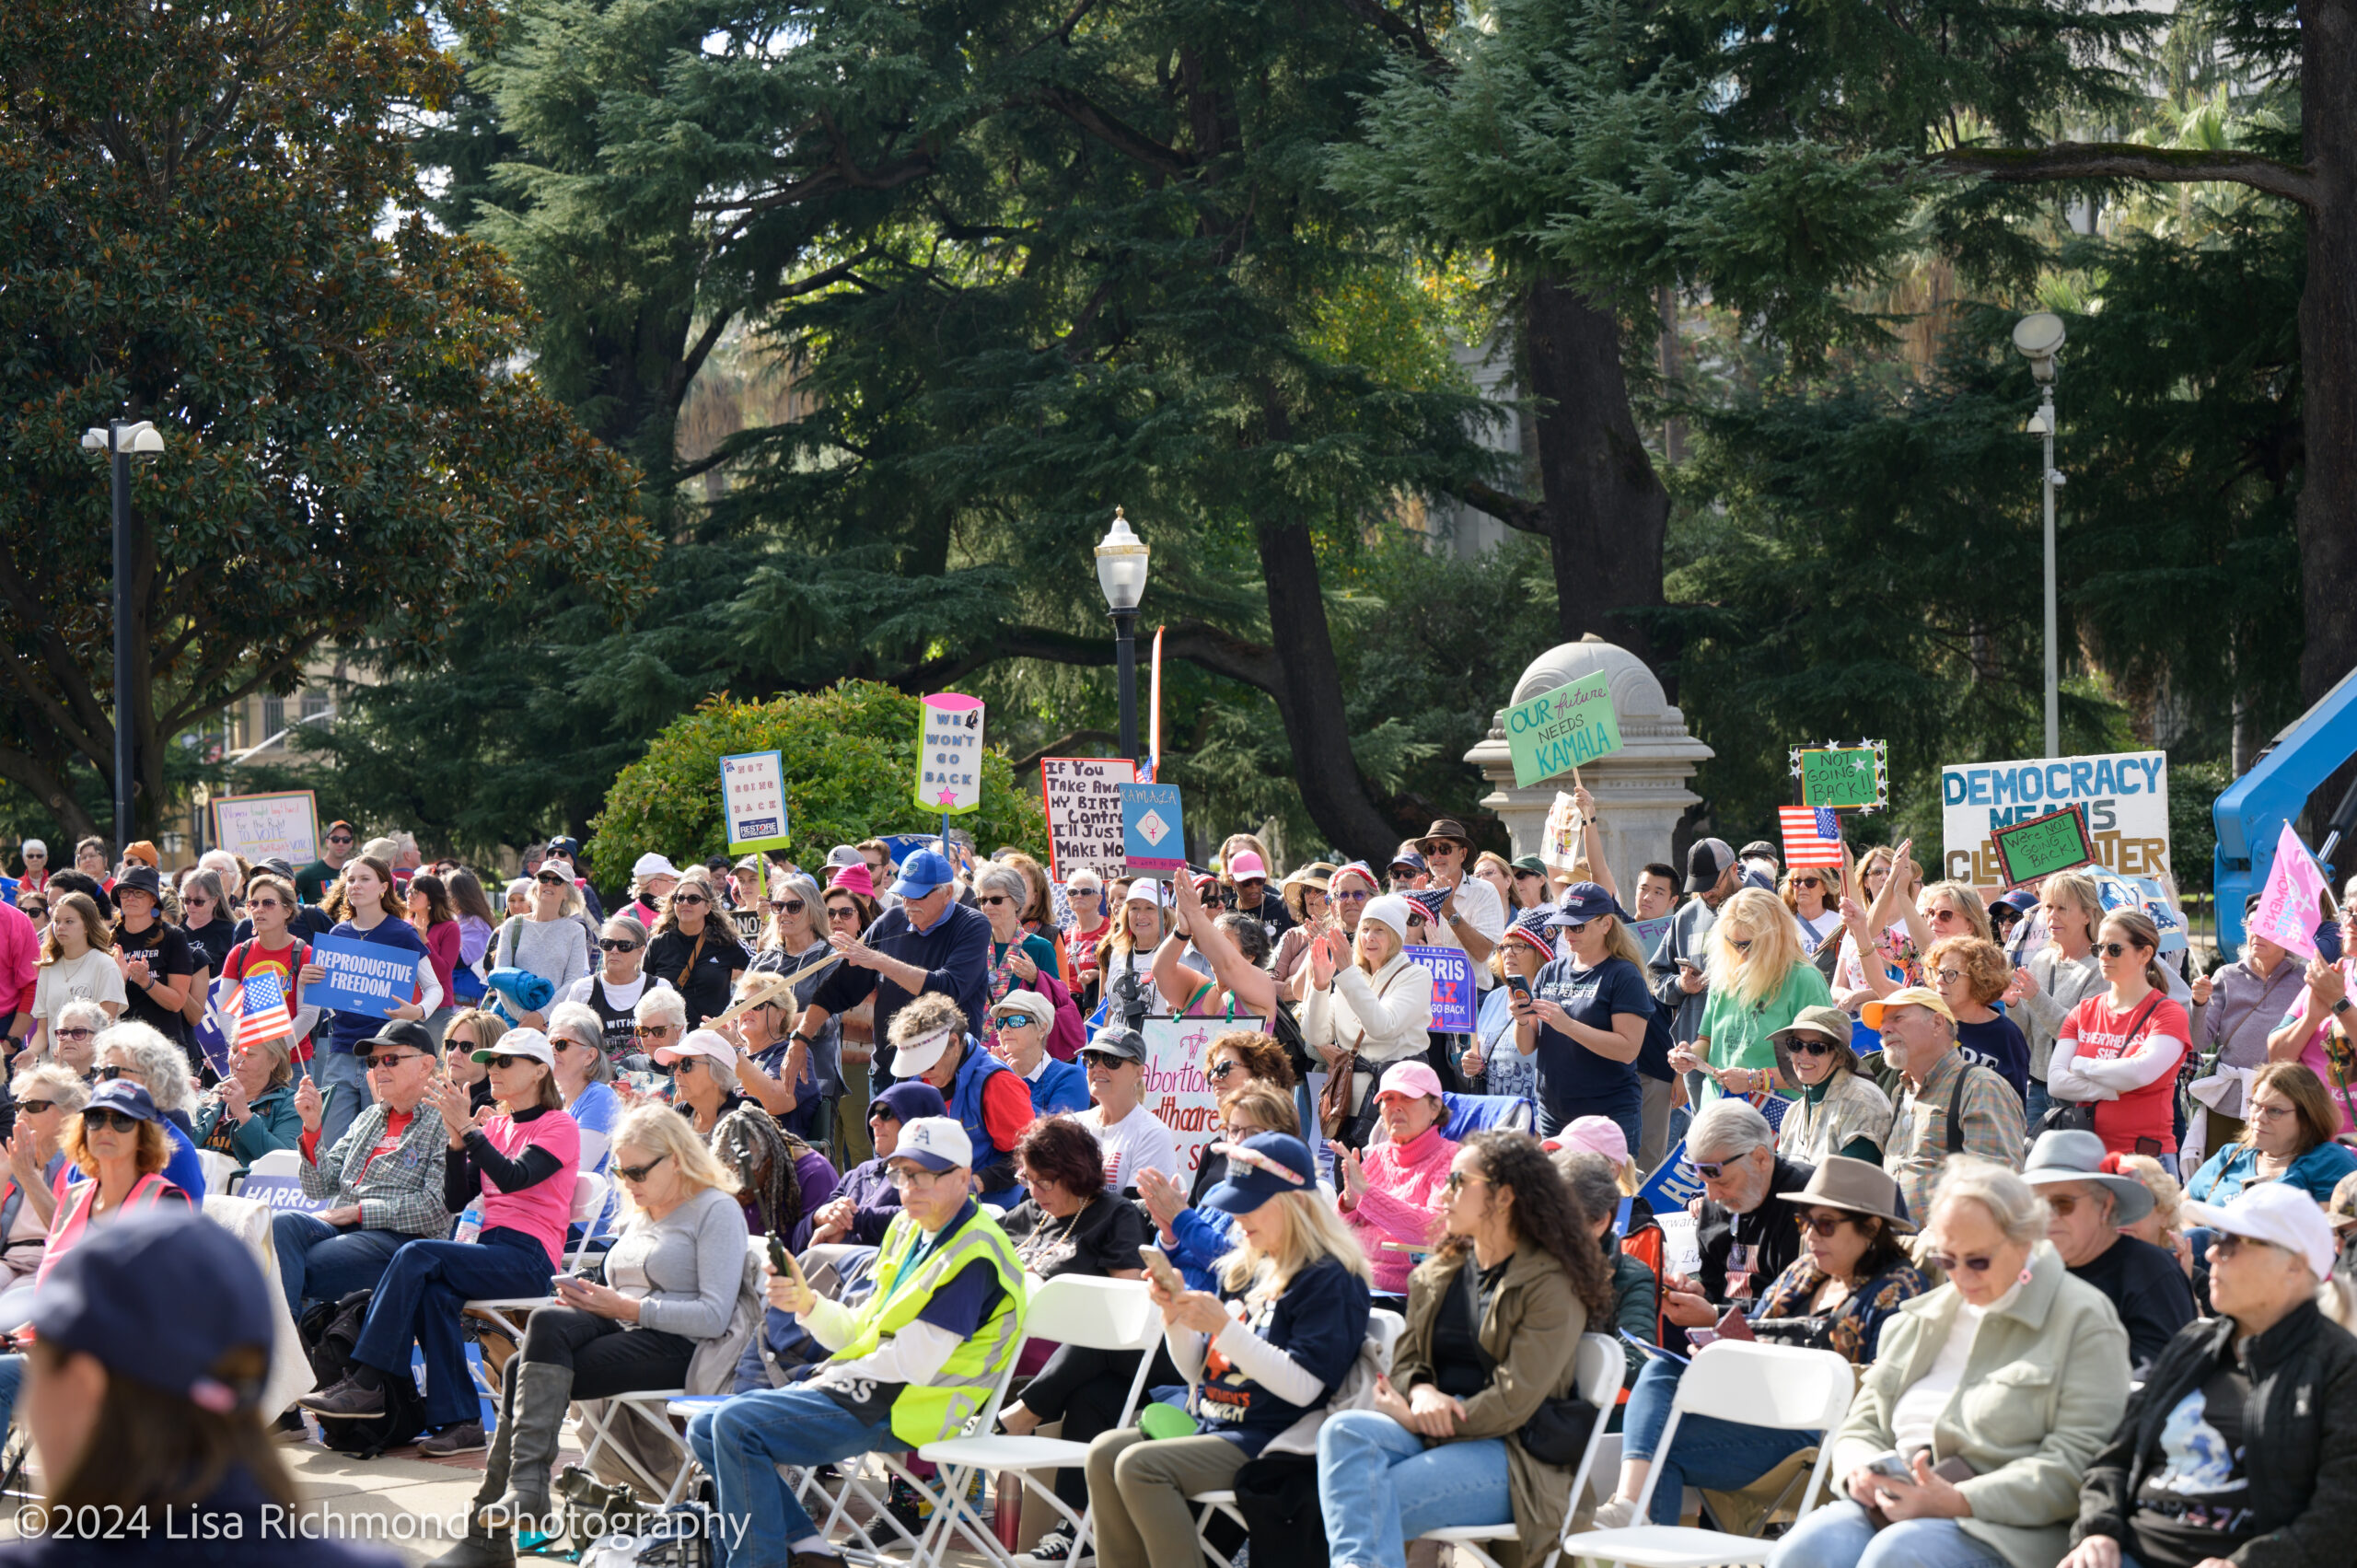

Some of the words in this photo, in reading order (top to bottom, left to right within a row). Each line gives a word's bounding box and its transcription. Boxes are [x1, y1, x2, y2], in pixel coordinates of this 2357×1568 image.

[1511, 699, 1553, 733] OUR
[1554, 688, 1607, 720] future
[936, 714, 961, 726] WE
[1538, 714, 1585, 744] NEEDS
[925, 734, 975, 747] WON'T
[1535, 722, 1611, 776] KAMALA
[936, 753, 959, 764] GO
[1820, 751, 1852, 766] NOT
[737, 762, 763, 774] NOT
[1806, 765, 1855, 782] GOING
[735, 780, 773, 793] GOING
[924, 772, 972, 785] BACK
[1943, 757, 2163, 806] DEMOCRACY
[1093, 780, 1120, 794] AWA
[1051, 796, 1070, 808] MY
[1078, 796, 1120, 809] BIRT
[1120, 788, 1178, 806] KAMALA
[735, 800, 777, 813] BACK
[1068, 808, 1123, 824] Contr
[740, 821, 776, 834] RESTORE
[2045, 817, 2068, 834] NOT
[238, 830, 250, 842] TO
[255, 827, 287, 842] VOTE
[1103, 842, 1124, 857] MO
[2021, 835, 2060, 856] GOING
[2028, 835, 2077, 868] BACK!
[2094, 830, 2166, 875] TER
[1945, 839, 2003, 886] CLE
[315, 949, 412, 983] REPRODUCTIVE
[1414, 958, 1465, 981] RRIS
[330, 971, 391, 998] FREEDOM
[1433, 981, 1457, 1004] LZ
[1558, 989, 1597, 998] PERSISTE
[1431, 1004, 1443, 1014] GO
[1444, 1004, 1466, 1015] BACK
[2078, 1028, 2145, 1049] NEVERTHESS
[2096, 1047, 2119, 1061] SHE
[1151, 1096, 1220, 1132] althcare
[1658, 1216, 1698, 1228] orwar
